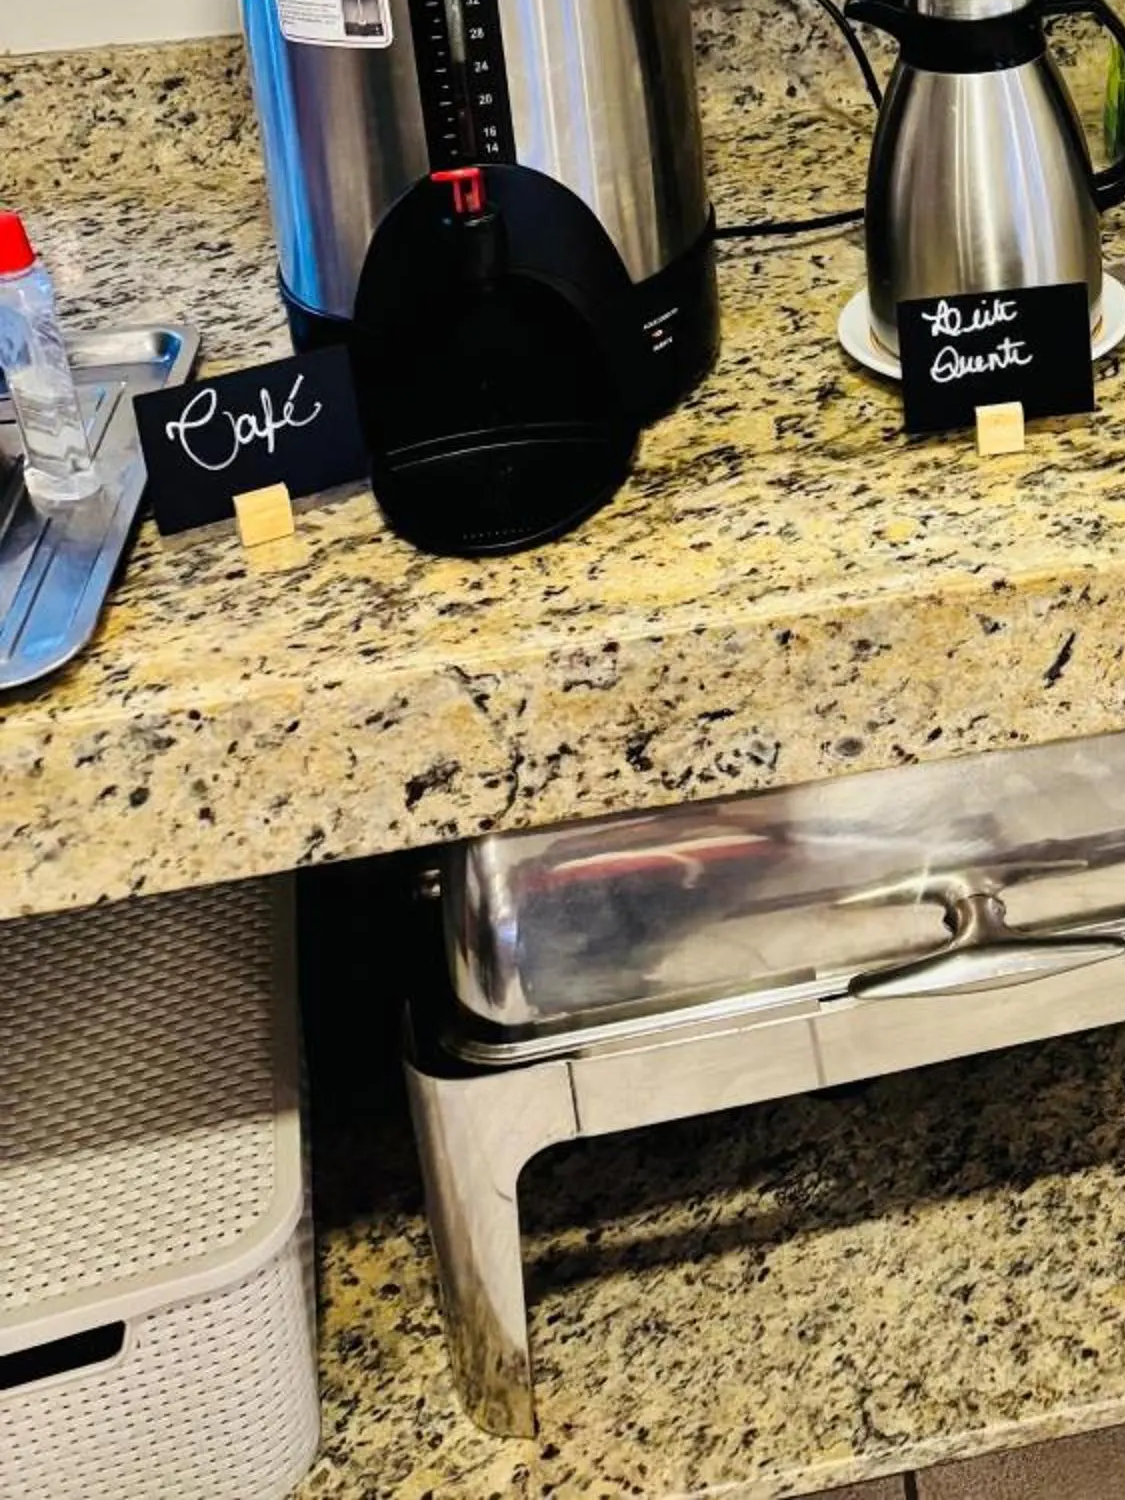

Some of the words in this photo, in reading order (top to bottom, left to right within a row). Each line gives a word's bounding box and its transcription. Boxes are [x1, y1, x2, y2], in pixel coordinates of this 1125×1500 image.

[483, 126, 497, 137] 16
[486, 142, 499, 153] 14
[164, 373, 323, 471] Café
